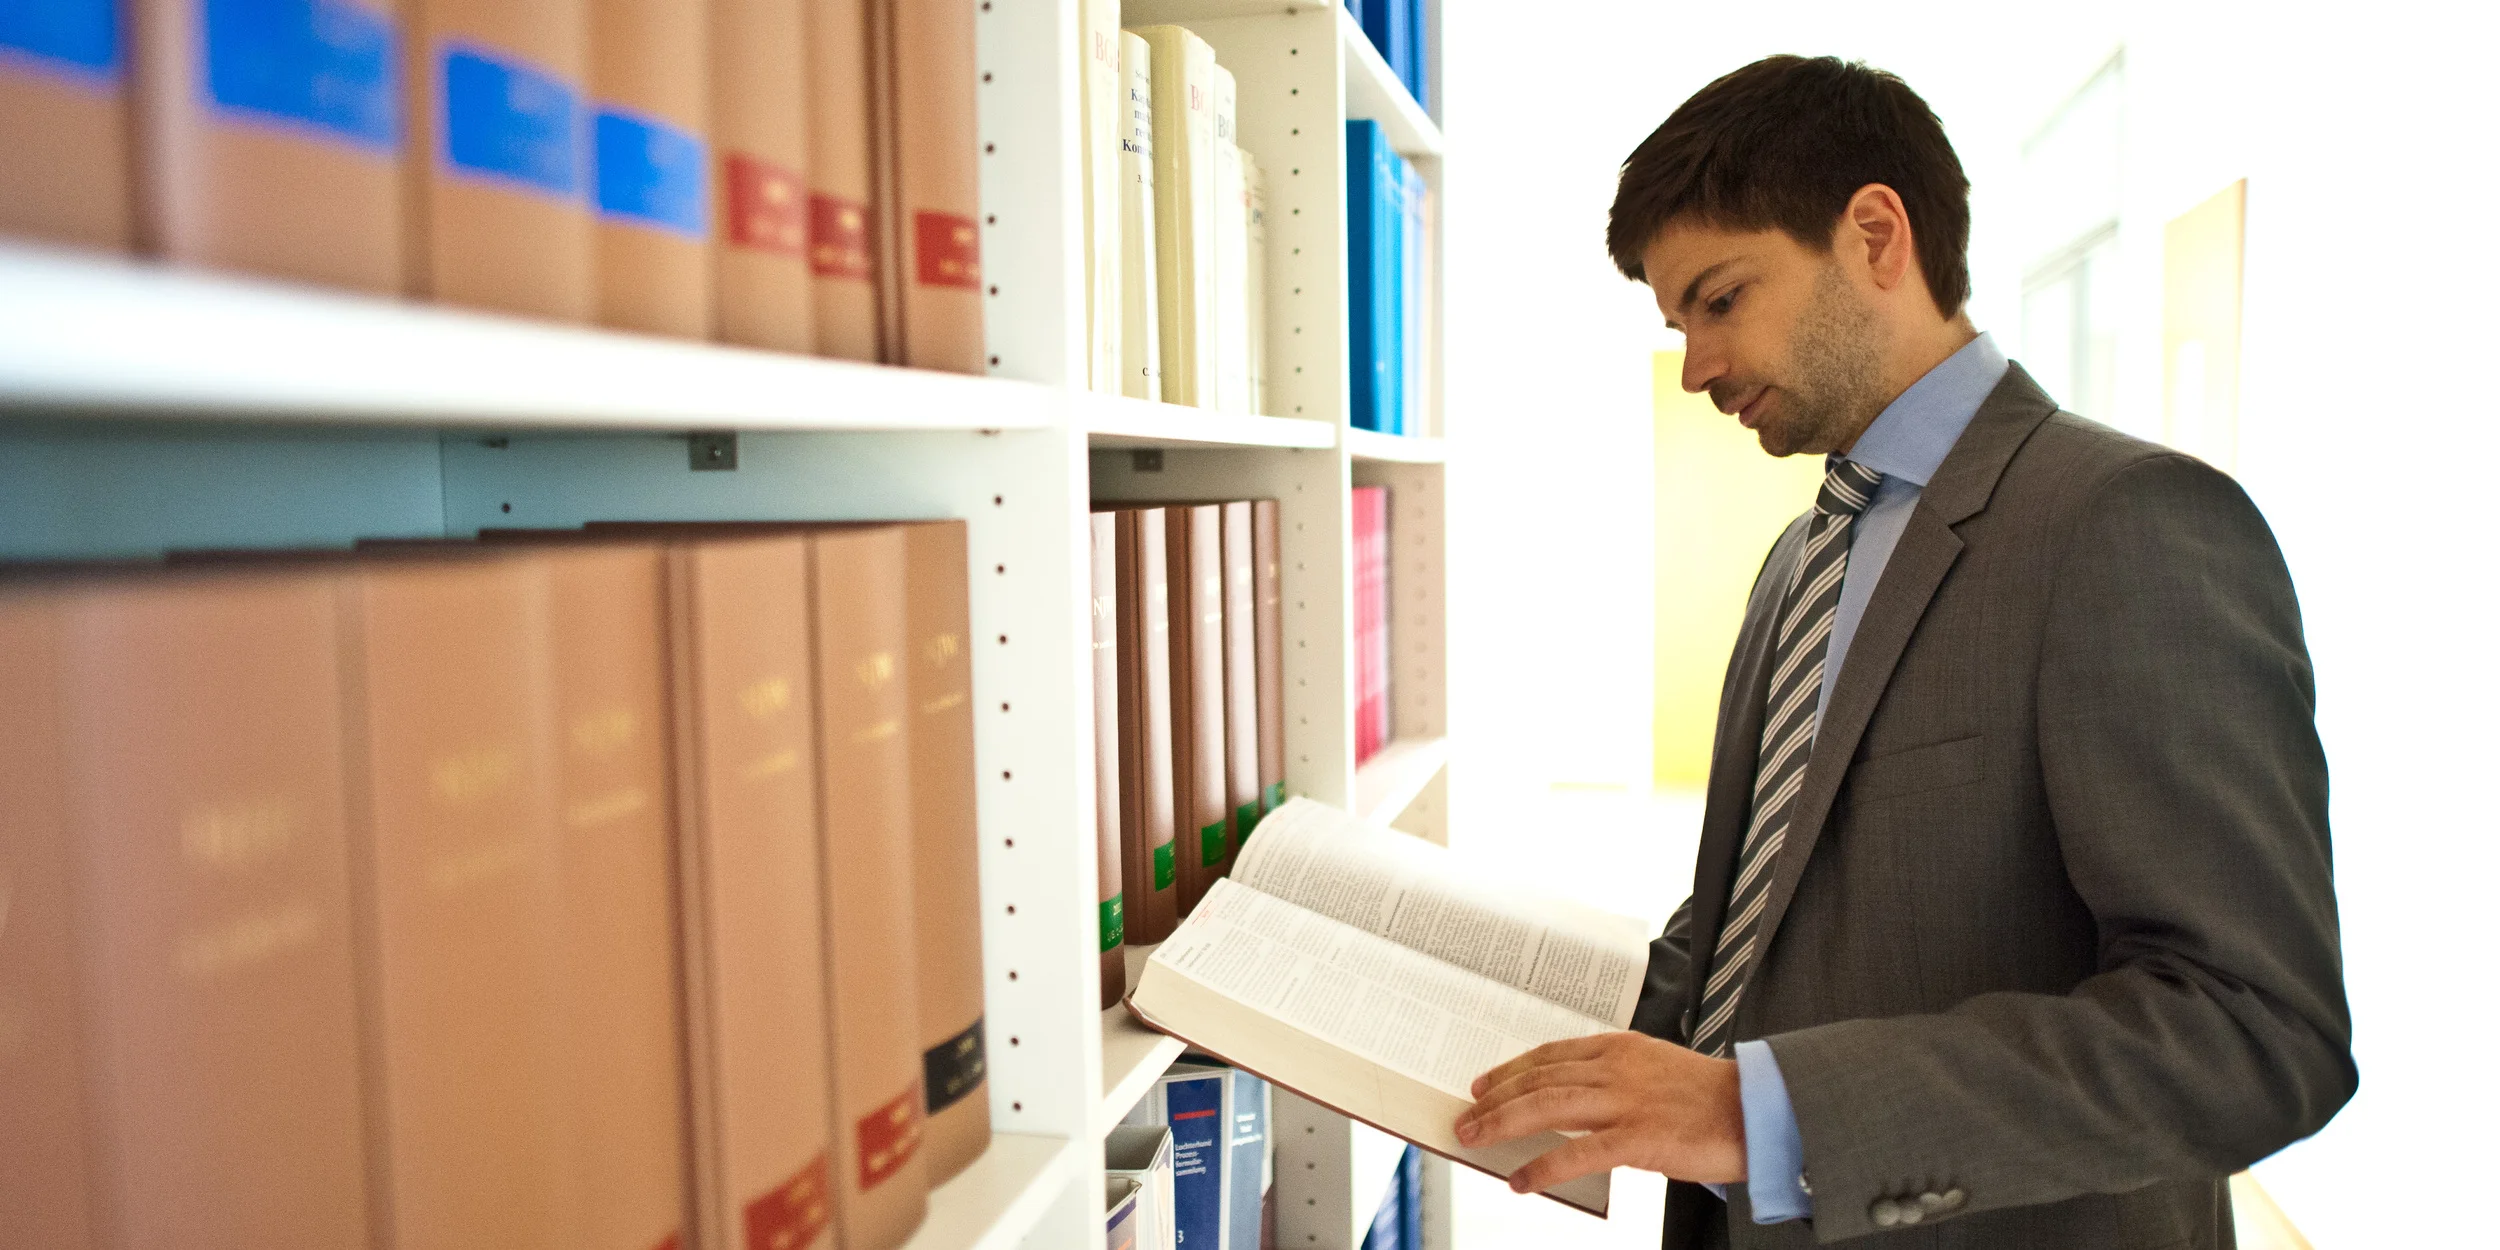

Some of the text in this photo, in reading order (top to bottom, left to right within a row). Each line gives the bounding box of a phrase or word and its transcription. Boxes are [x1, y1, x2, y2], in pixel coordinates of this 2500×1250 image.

[1175, 1139, 1212, 1151] Luchterhand
[1175, 1166, 1206, 1177] sammlung
[1177, 1230, 1184, 1243] 3
